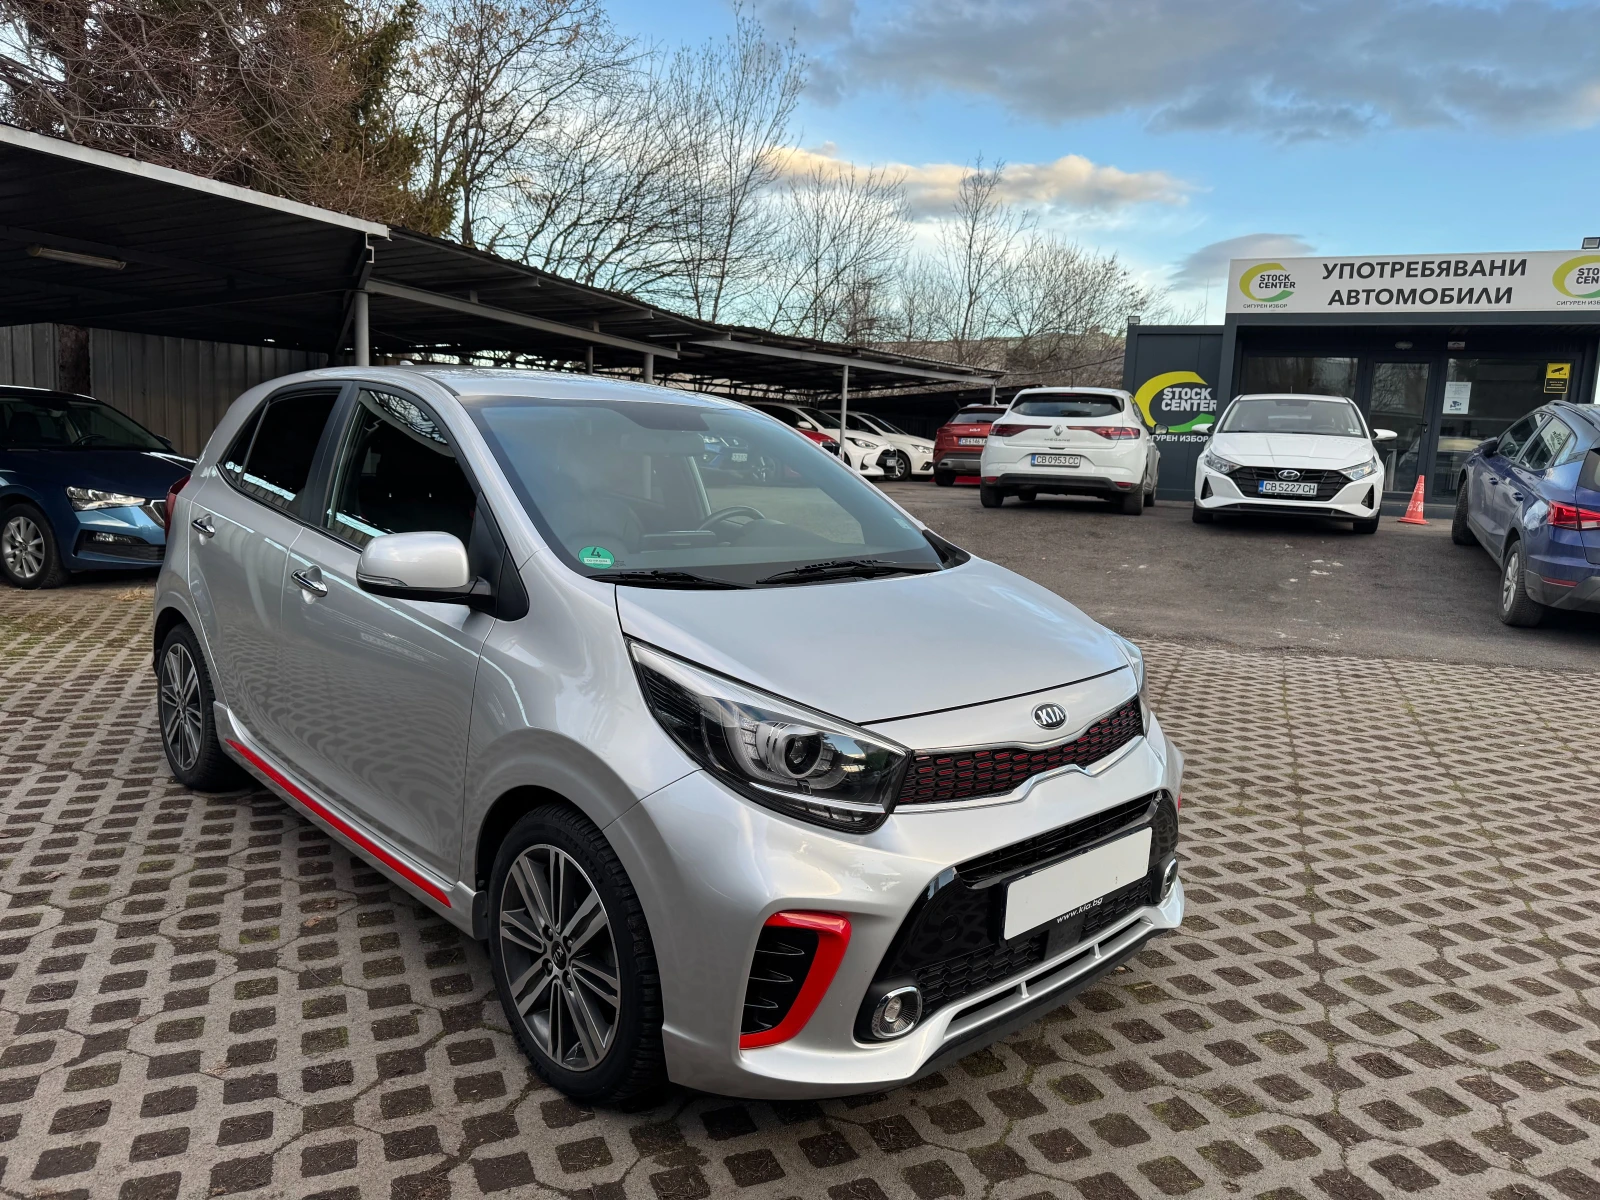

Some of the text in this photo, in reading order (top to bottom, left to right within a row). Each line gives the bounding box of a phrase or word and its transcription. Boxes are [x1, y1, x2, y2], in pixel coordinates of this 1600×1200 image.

[1322, 259, 1527, 279] УПОТРЕБЯВАНИ
[1258, 281, 1296, 289] CENTER
[1327, 287, 1513, 306] АВТОМОБИЛИ
[1162, 387, 1213, 400] STOCK
[1161, 399, 1217, 412] CENTER
[1150, 434, 1209, 443] ГУРЕН ИЗБОР
[1036, 455, 1079, 465] CB 0953 CC
[1264, 482, 1316, 493] CB 5227 CH
[591, 547, 601, 558] 4
[1037, 706, 1065, 725] KIA
[1056, 897, 1103, 924] www.kia.bg
